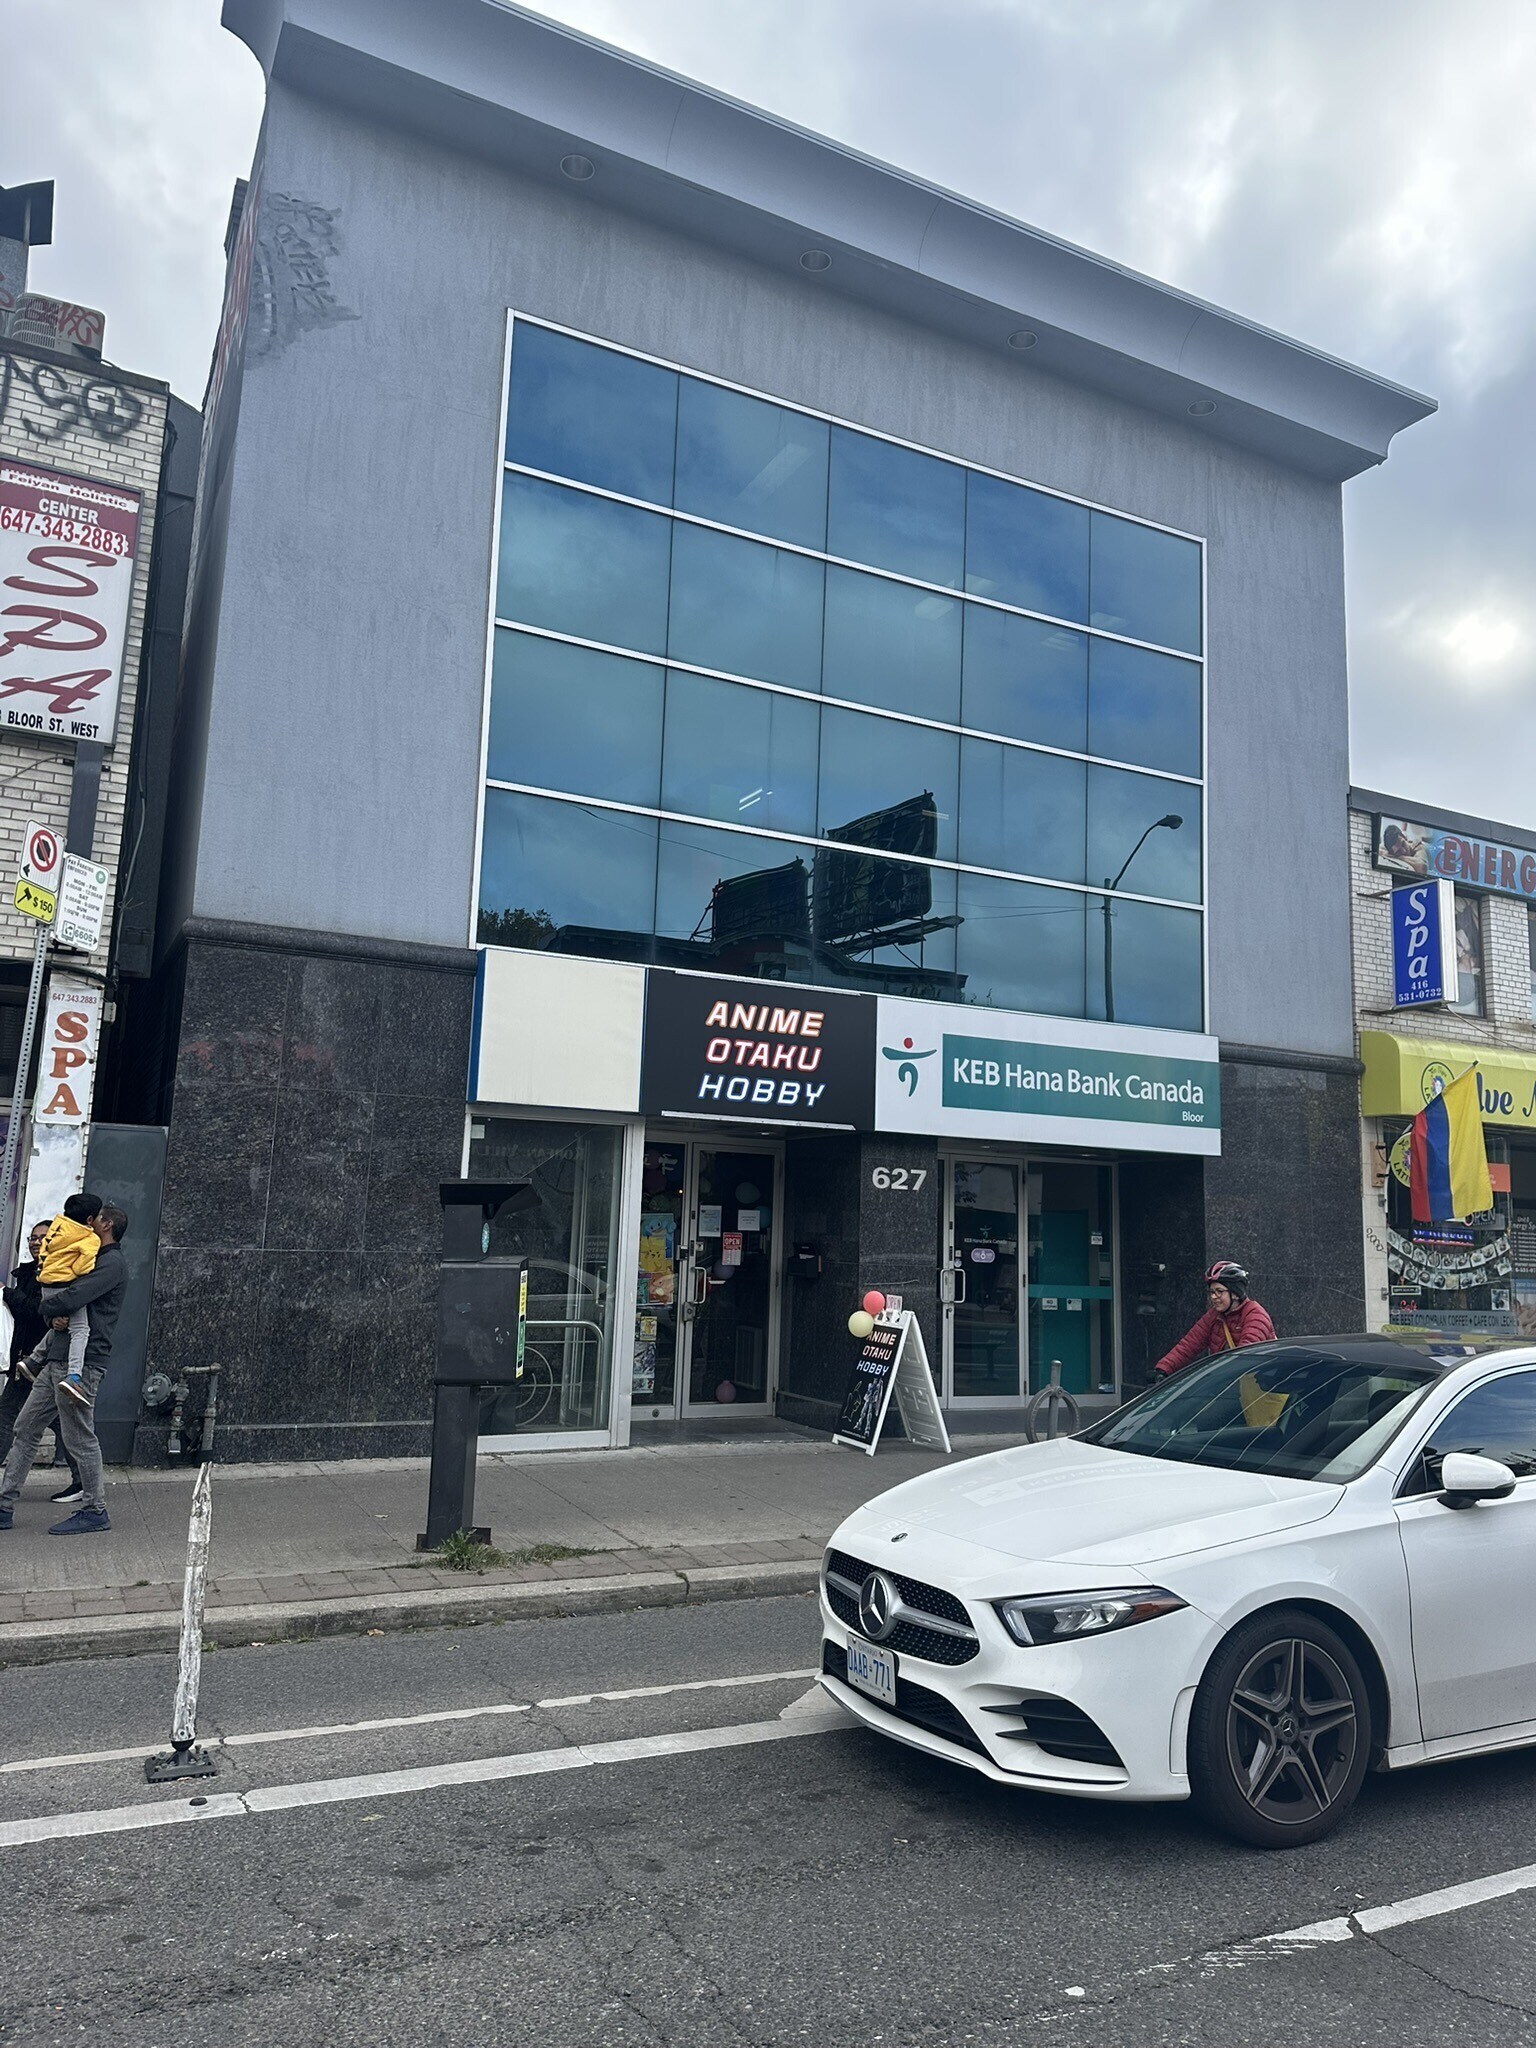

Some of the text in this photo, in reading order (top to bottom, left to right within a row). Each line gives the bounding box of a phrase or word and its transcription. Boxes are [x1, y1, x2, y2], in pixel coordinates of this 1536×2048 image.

[9, 474, 128, 508] Feiyan Holistic
[38, 498, 99, 525] CENTER
[0, 507, 124, 555] 647-343-2883
[0, 546, 117, 714] SPA
[8, 710, 99, 738] BLOOR ST. WEST
[33, 896, 53, 913] $150
[74, 930, 93, 942] 6605
[1405, 888, 1428, 979] Spa
[1398, 987, 1442, 1002] 531-0732
[1411, 980, 1428, 990] 416
[52, 992, 97, 1004] 647 343 2883
[705, 1000, 825, 1037] ANIME
[42, 1010, 95, 1116] SPA
[705, 1037, 822, 1072] OTAKU
[698, 1073, 825, 1108] HOBBY
[953, 1057, 1204, 1105] KEB Hana Bank Canada
[1182, 1110, 1205, 1123] Bloor
[872, 1167, 927, 1191] 627
[725, 1237, 740, 1245] OPEN
[1448, 1315, 1469, 1327] COFFEE
[866, 1331, 897, 1346] ANIME
[862, 1345, 892, 1361] OTAKU
[856, 1360, 890, 1377] HOBBY
